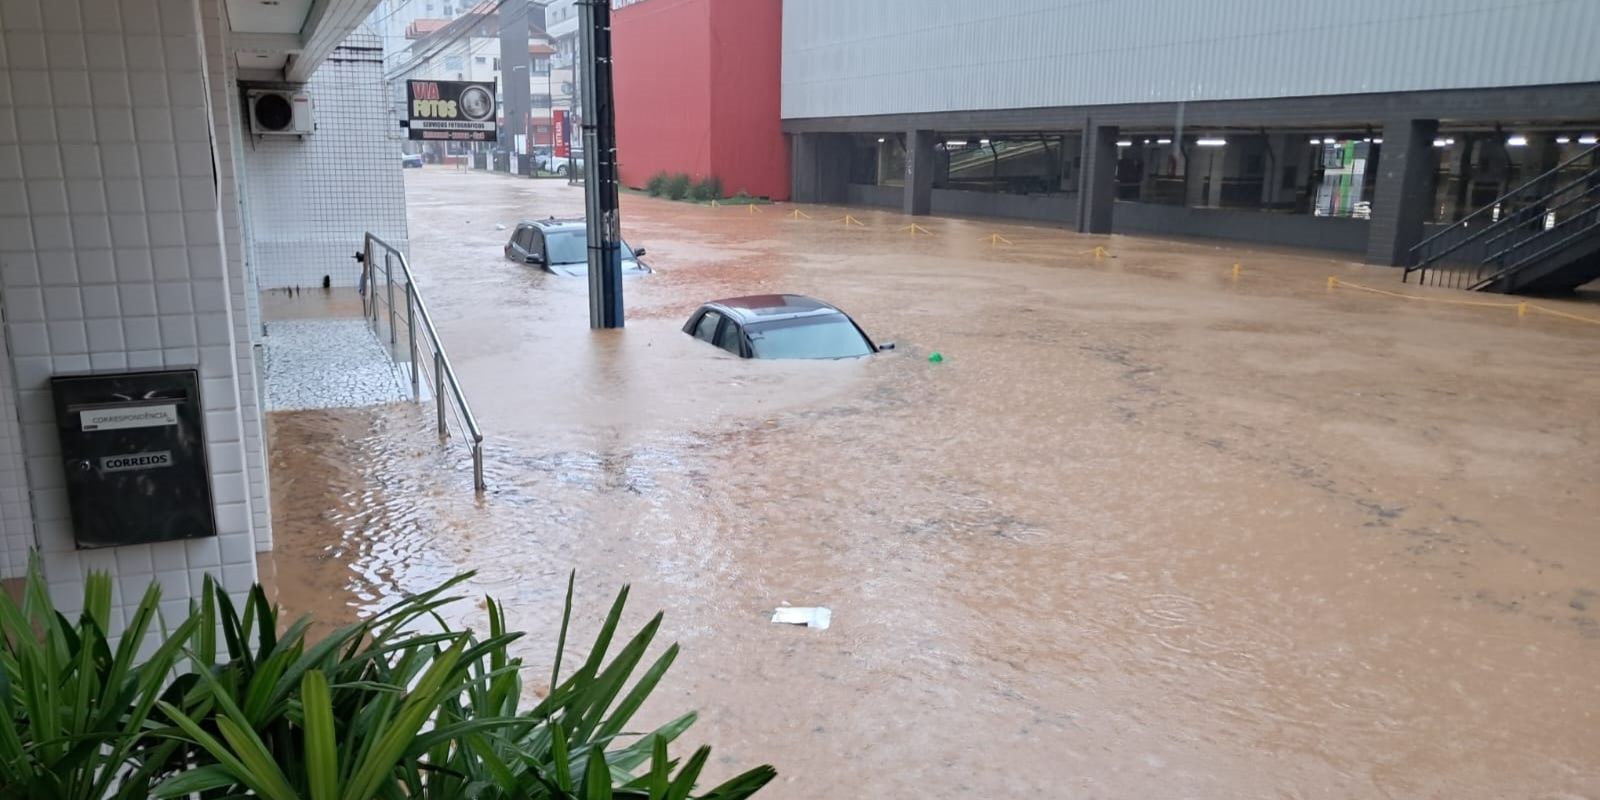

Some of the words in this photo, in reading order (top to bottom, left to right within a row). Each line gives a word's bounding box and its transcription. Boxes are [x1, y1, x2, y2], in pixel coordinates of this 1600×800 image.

[412, 82, 440, 99] VIA
[413, 99, 457, 118] FOTOS
[92, 411, 168, 424] CORRESPONDÊNCIA
[106, 454, 167, 469] CORREIOS
